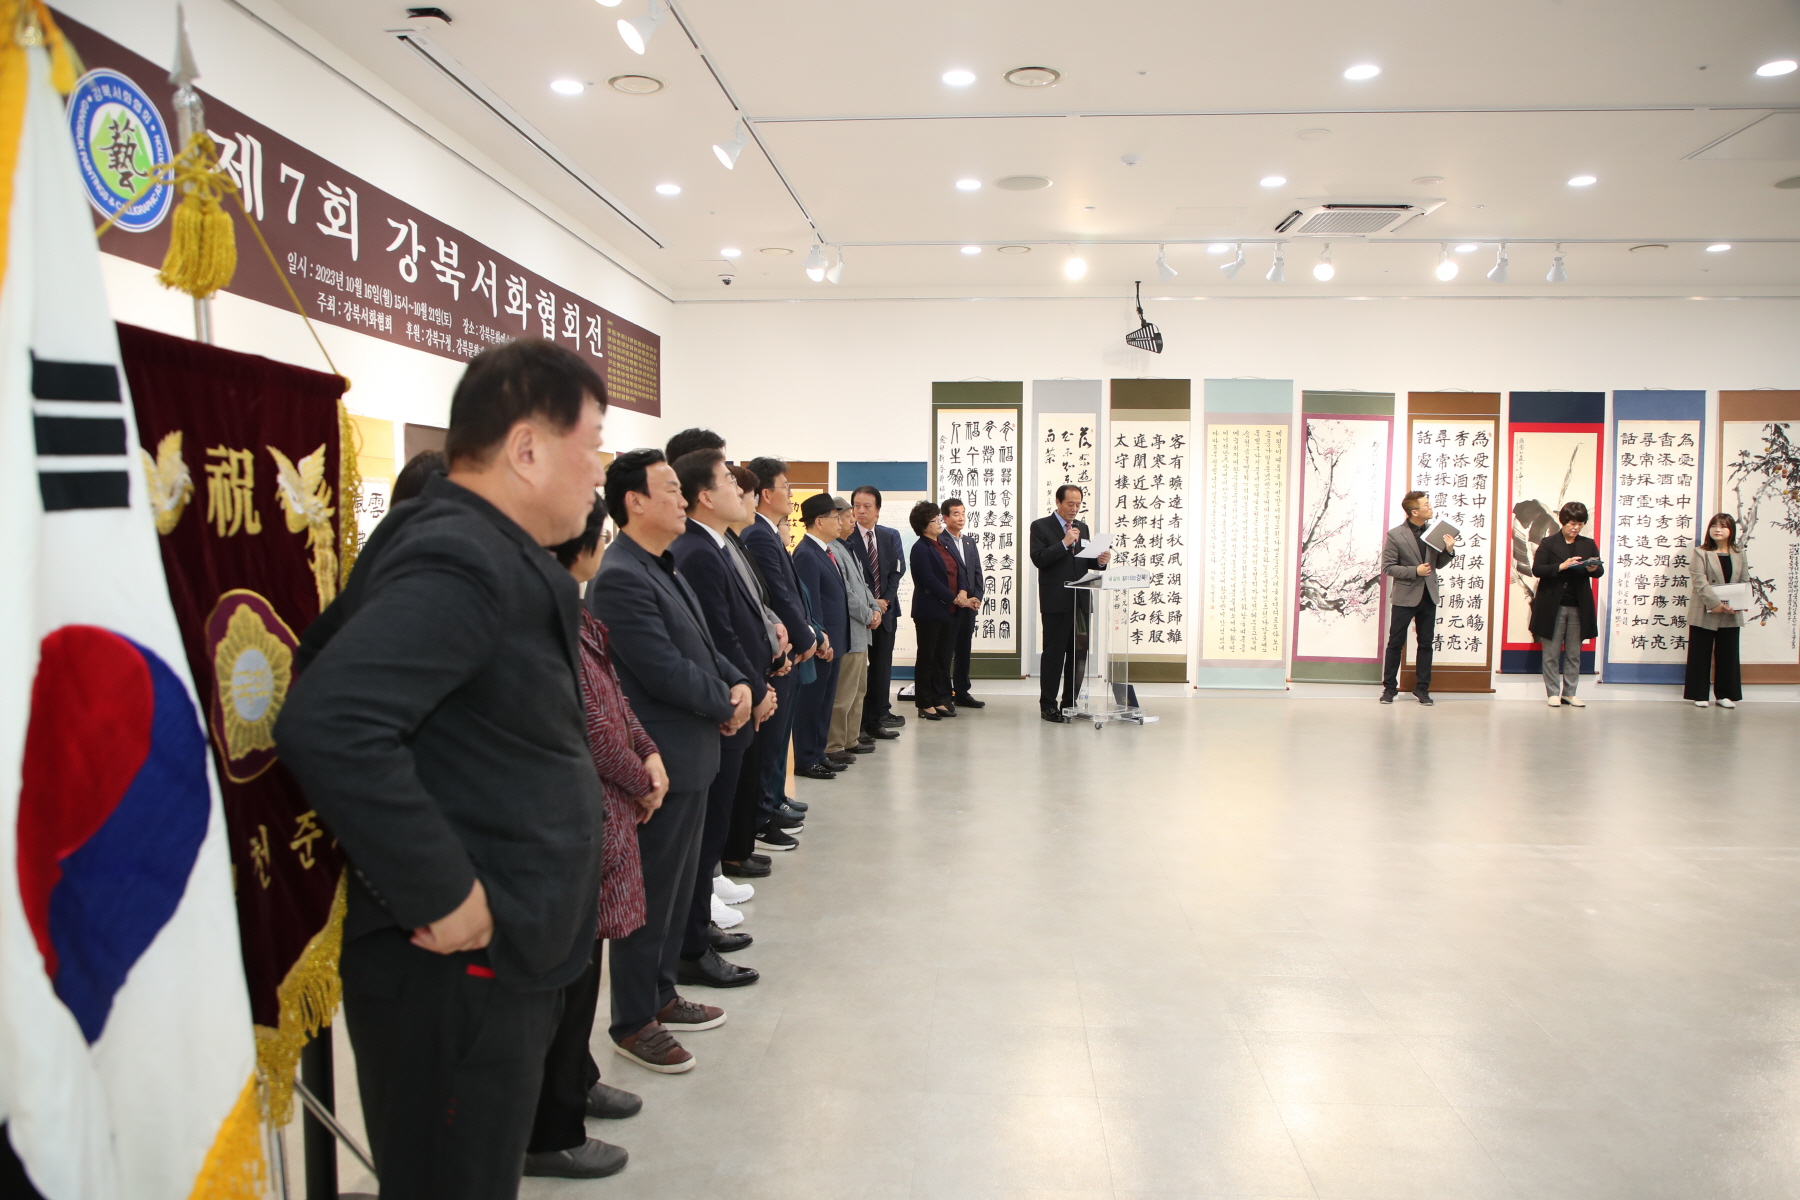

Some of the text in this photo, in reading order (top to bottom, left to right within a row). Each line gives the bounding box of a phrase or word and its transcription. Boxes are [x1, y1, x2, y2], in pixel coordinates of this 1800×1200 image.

[315, 264, 344, 292] 2023년
[345, 275, 363, 299] 10월
[364, 282, 393, 309] 16일(월)
[428, 306, 453, 329] 21일(토)
[343, 300, 393, 335] 강북서화협회
[385, 217, 603, 358] 강북서화협회전
[204, 443, 263, 538] 祝
